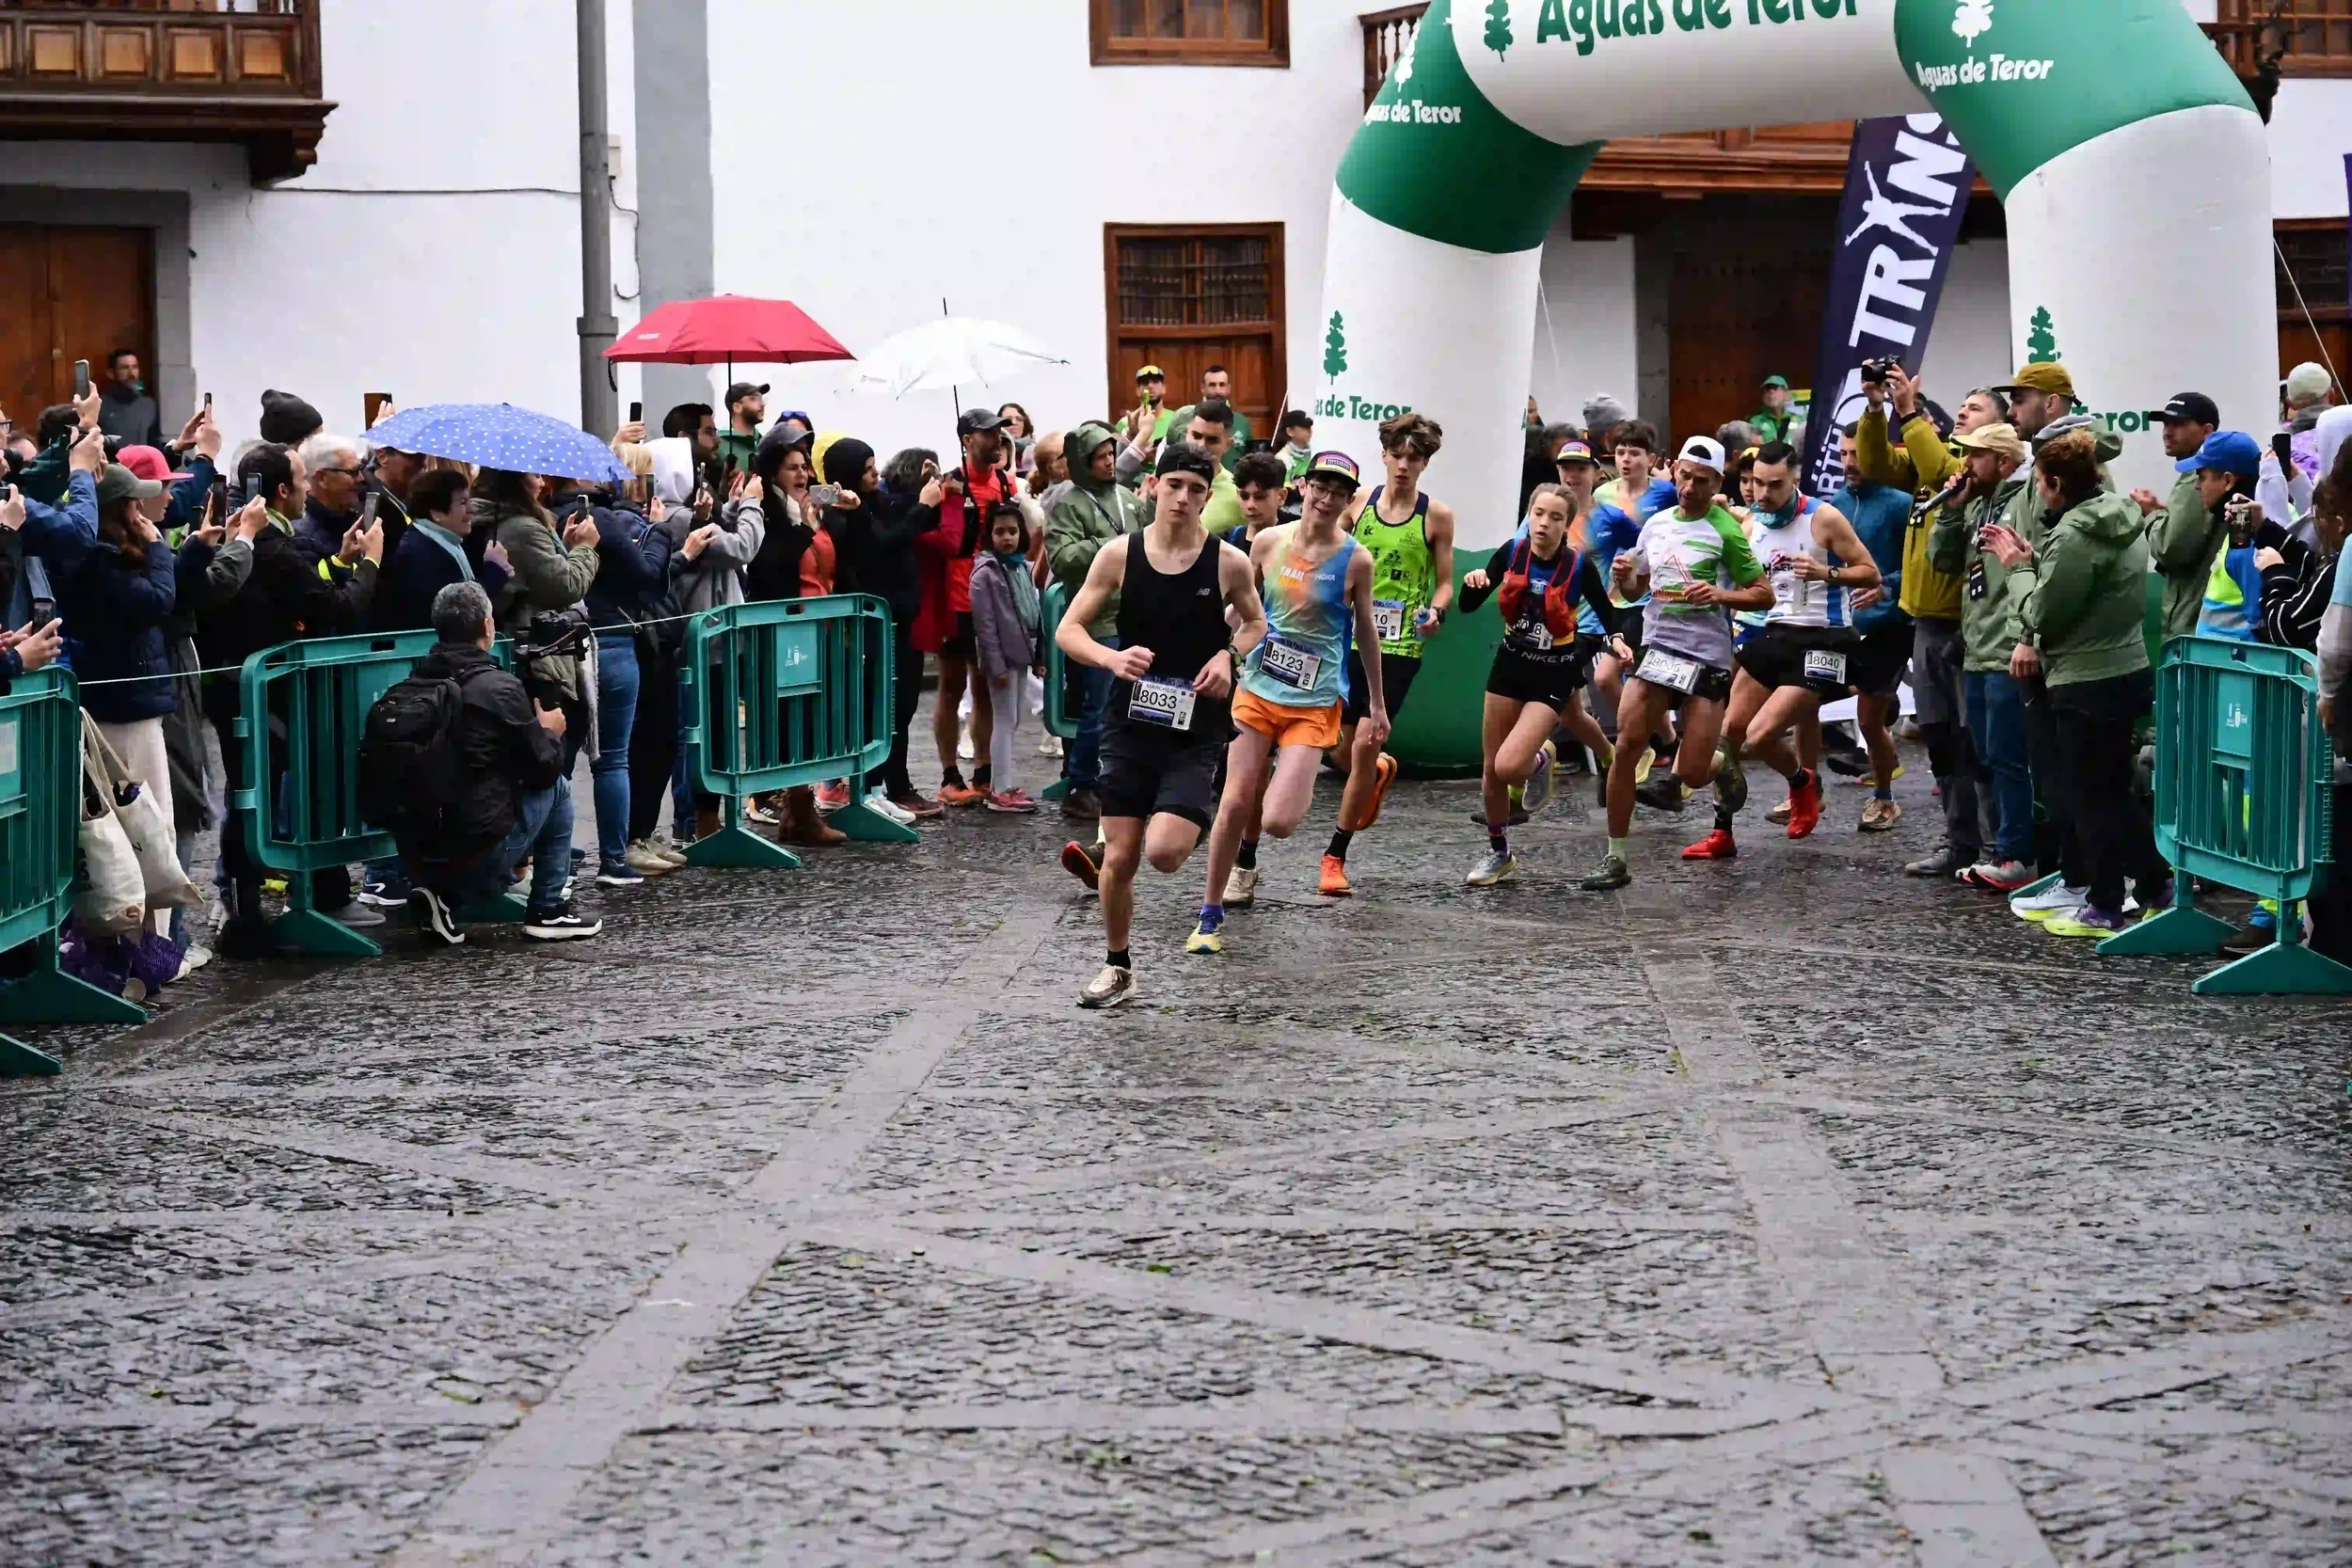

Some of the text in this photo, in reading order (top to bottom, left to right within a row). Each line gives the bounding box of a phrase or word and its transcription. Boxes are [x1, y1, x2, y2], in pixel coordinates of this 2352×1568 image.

[1915, 54, 2055, 92] Aguas de Teror
[1391, 99, 1411, 123] de
[1411, 100, 1462, 124] Teror
[1325, 394, 1345, 419] de
[2071, 405, 2151, 433] Tror
[1271, 649, 1304, 672] 8123
[1520, 651, 1558, 663] NIKE
[1813, 656, 1840, 669] 8040
[1139, 689, 1178, 709] 8033
